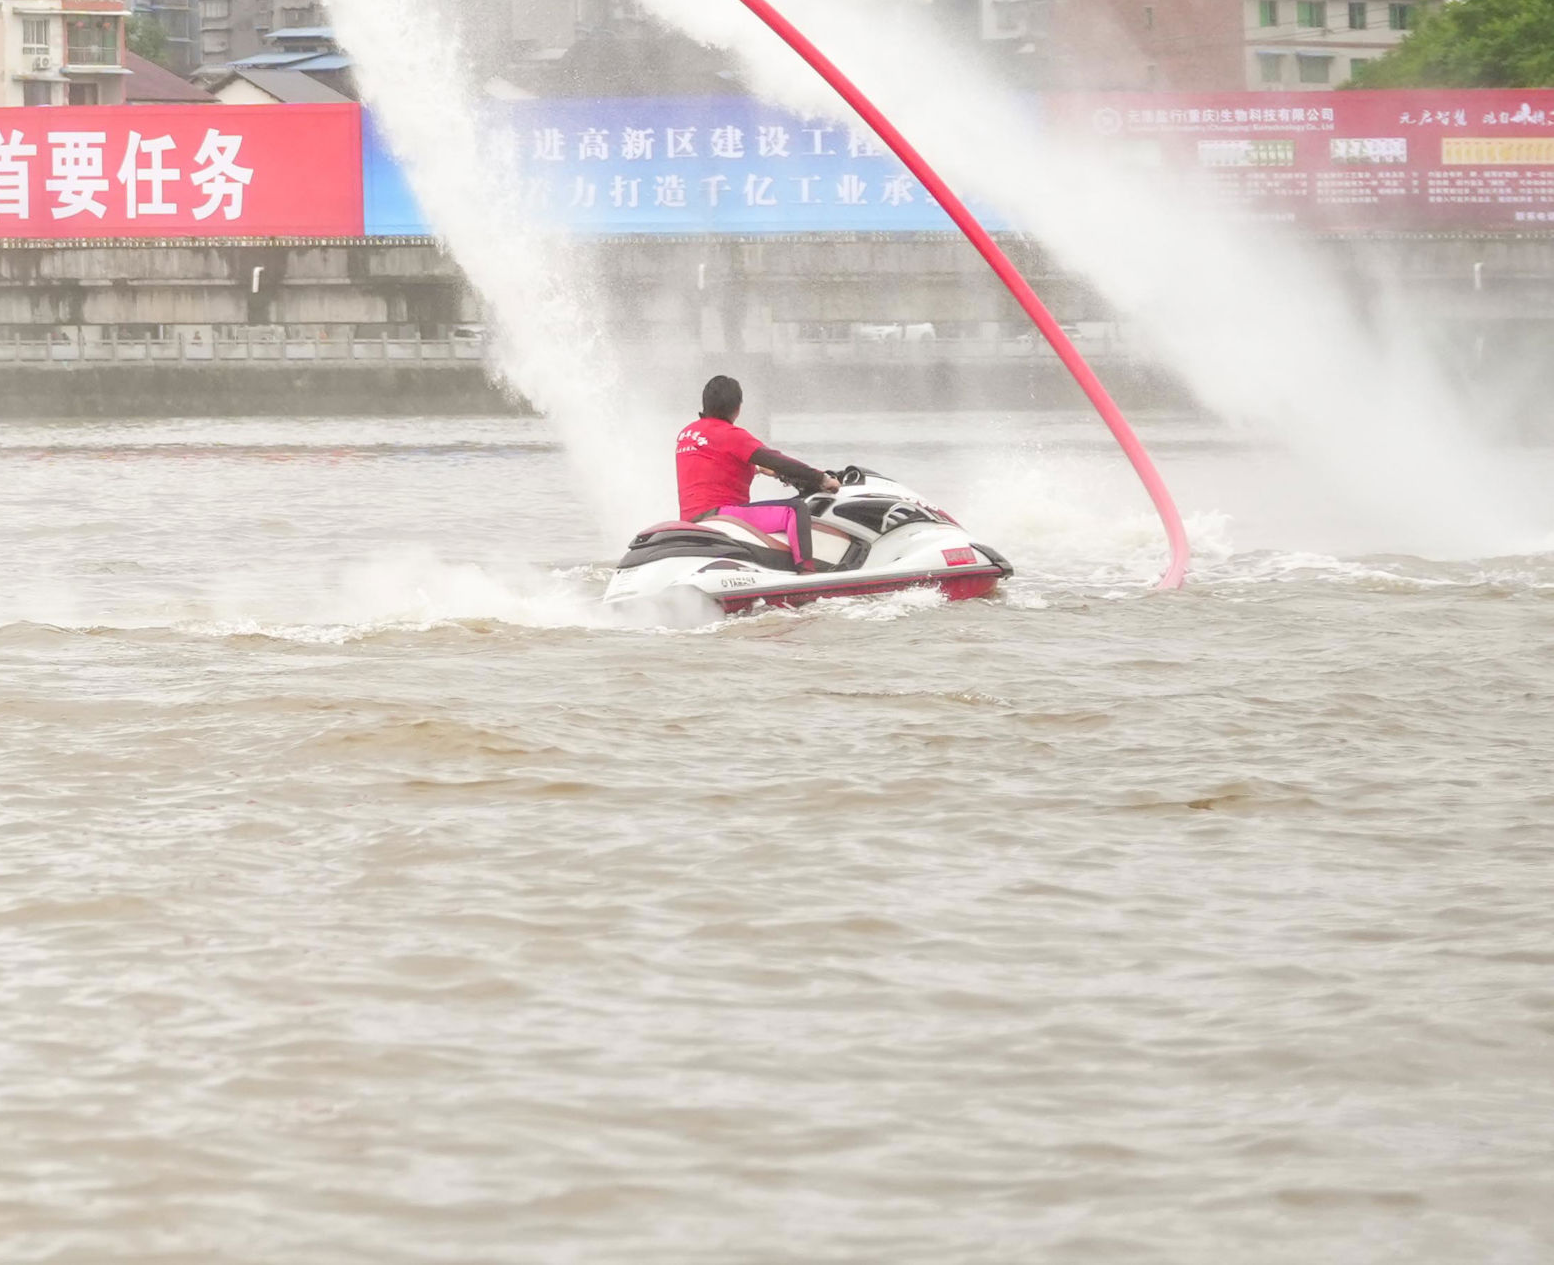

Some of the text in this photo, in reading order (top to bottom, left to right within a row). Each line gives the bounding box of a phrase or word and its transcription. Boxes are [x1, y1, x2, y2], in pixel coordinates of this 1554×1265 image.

[489, 125, 886, 163] 进高新区建设工程
[524, 173, 944, 208] 力打造千亿工业承
